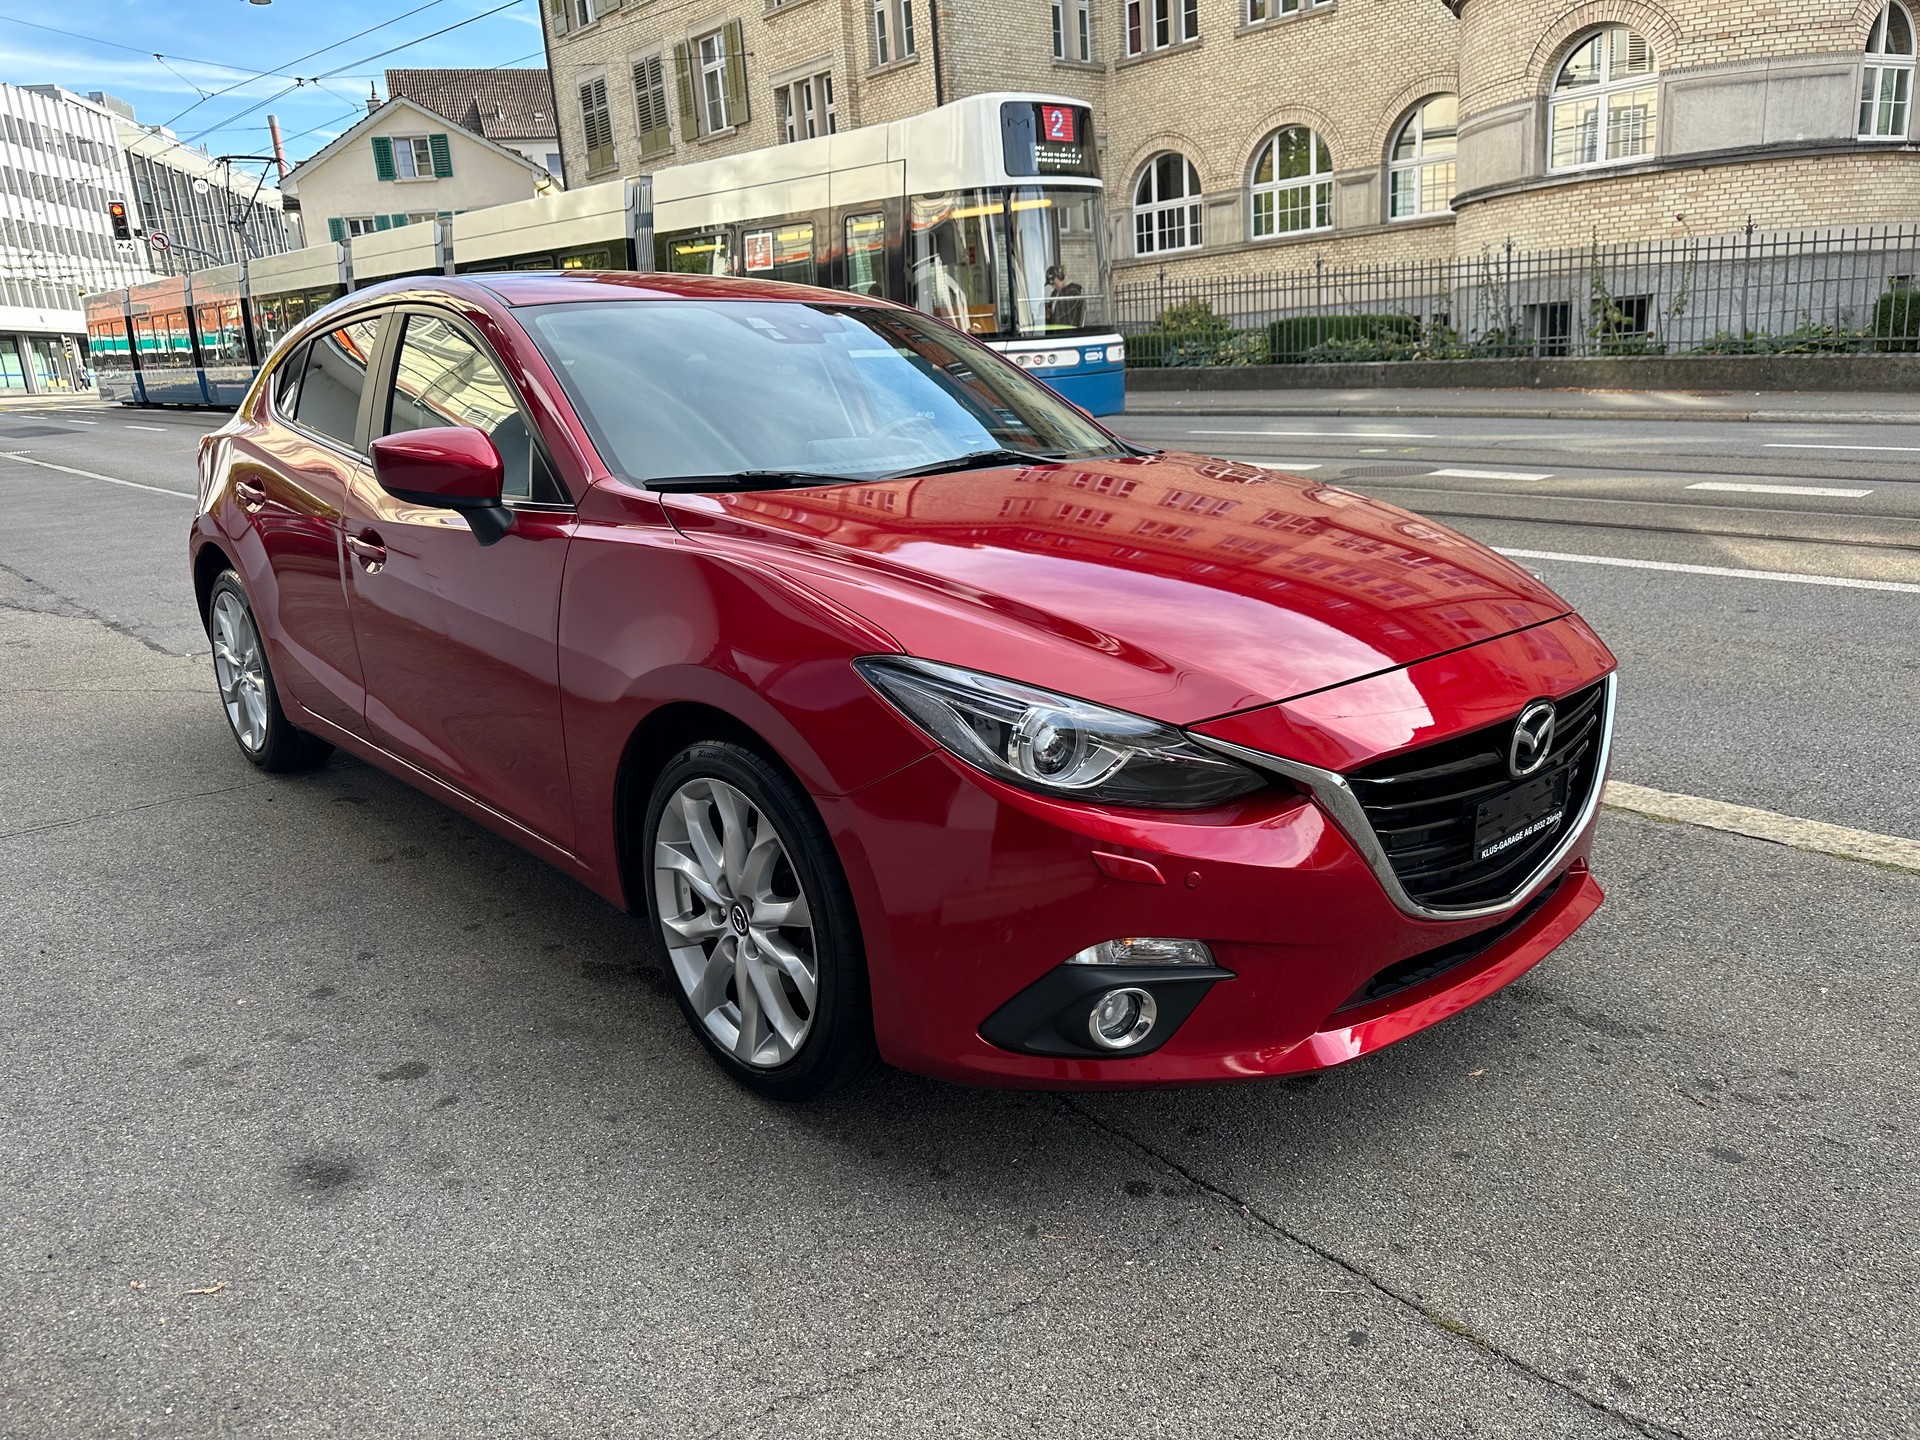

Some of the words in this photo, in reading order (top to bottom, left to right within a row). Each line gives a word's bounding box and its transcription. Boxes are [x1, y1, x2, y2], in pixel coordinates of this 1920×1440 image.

[1051, 110, 1064, 137] 2
[1481, 831, 1523, 859] KLUS-GARAGE
[1524, 827, 1533, 837] AG
[1533, 821, 1546, 832] 8032
[1546, 811, 1562, 826] Zürich
